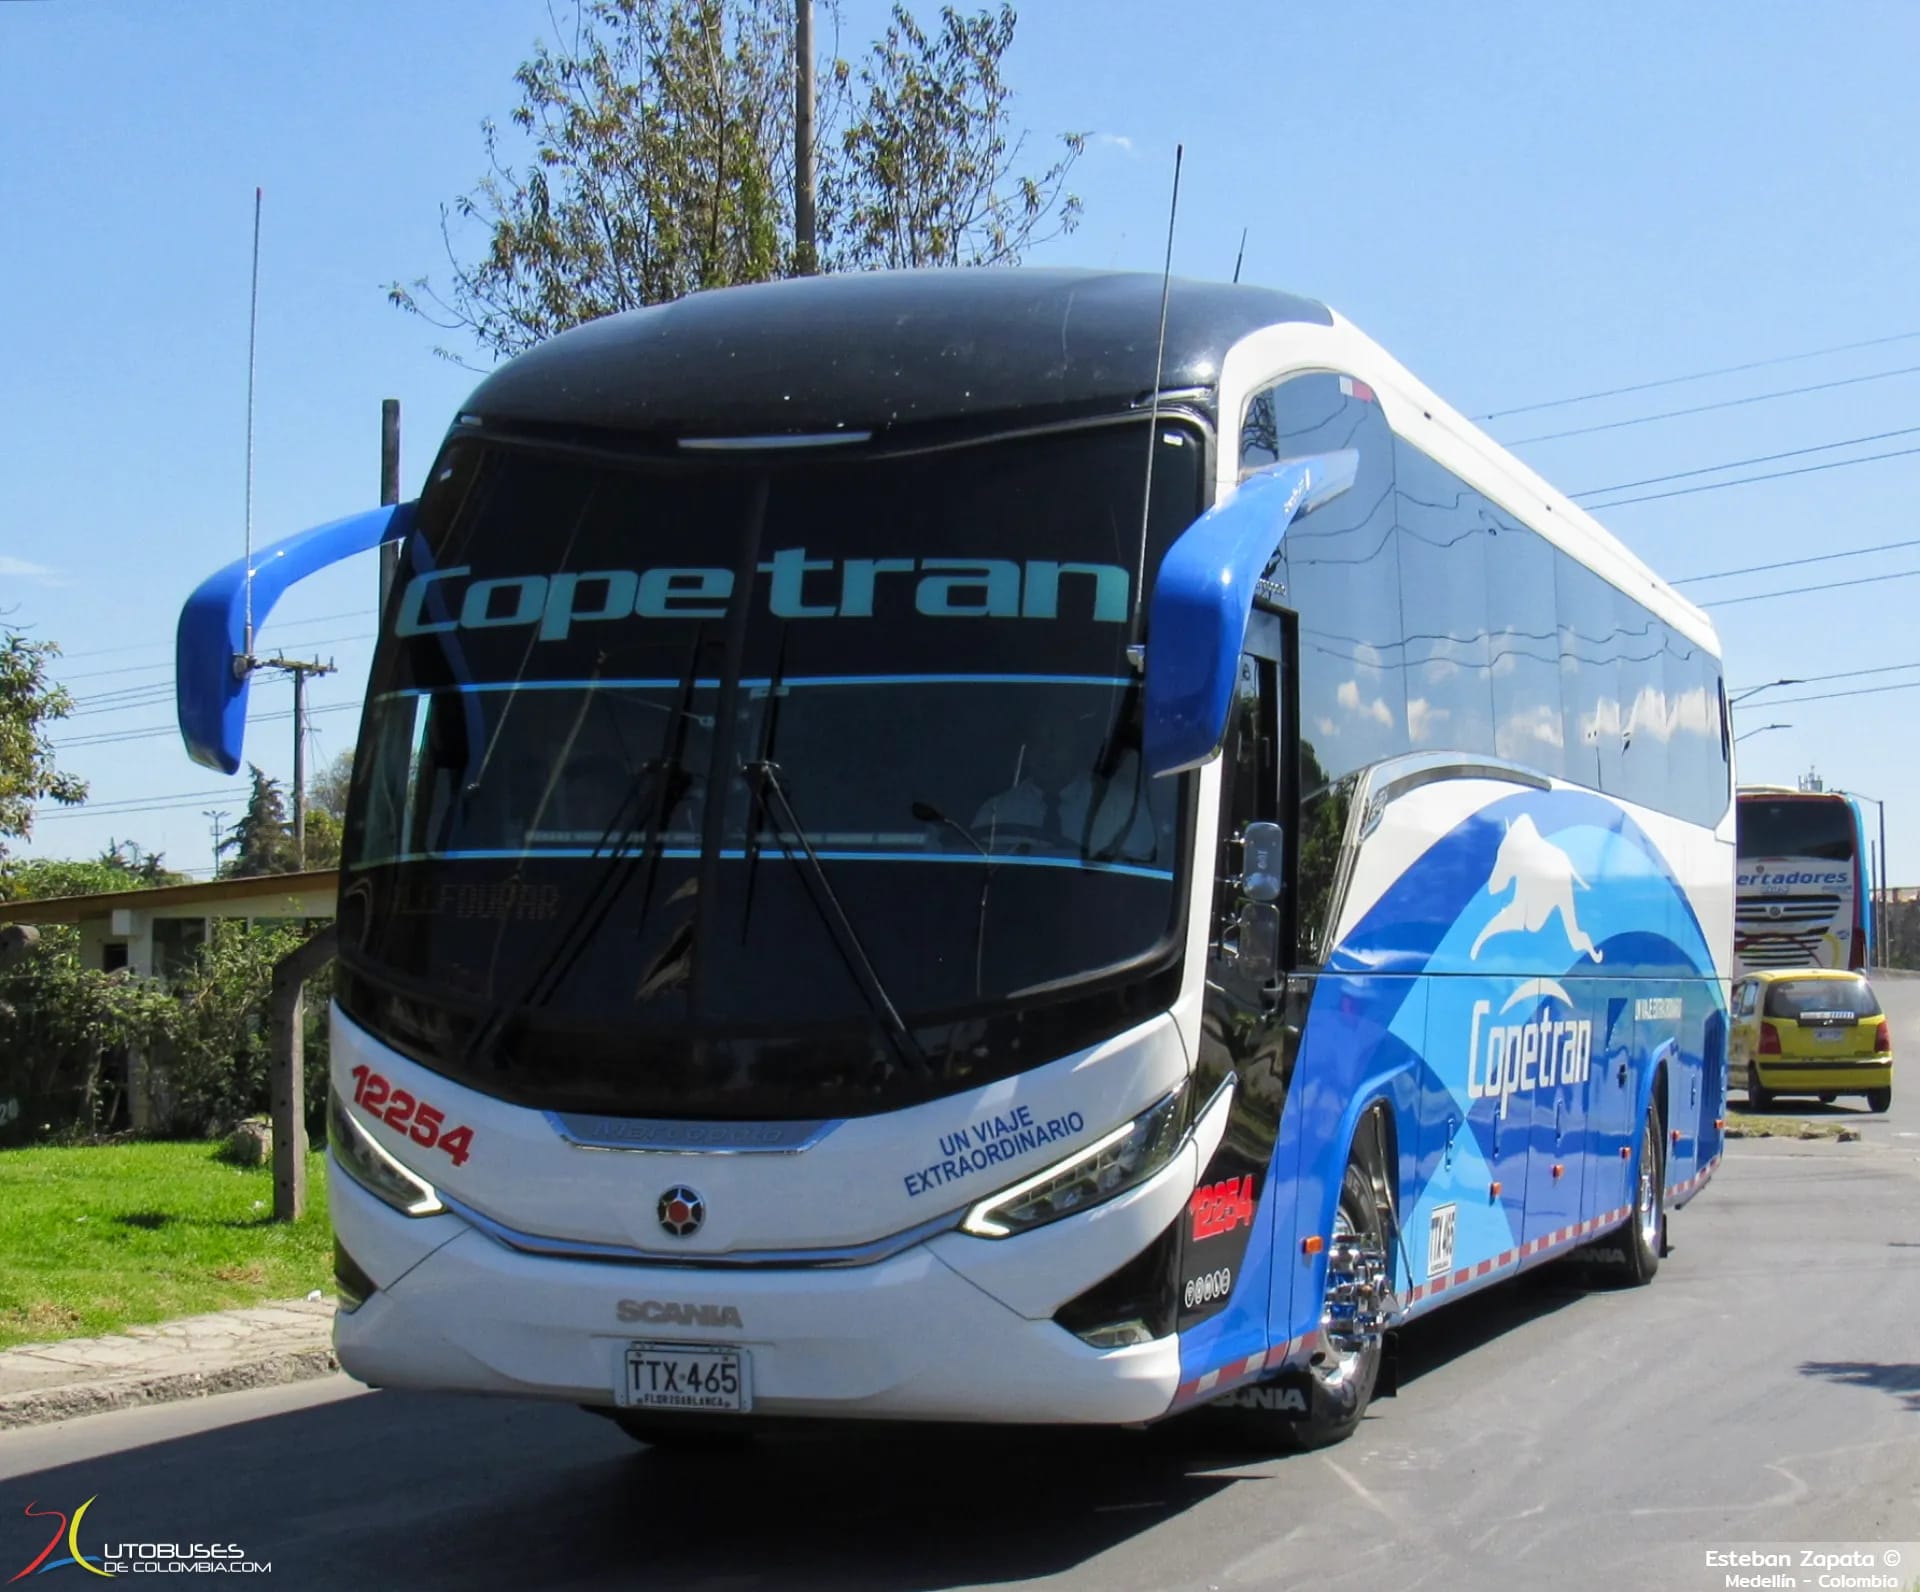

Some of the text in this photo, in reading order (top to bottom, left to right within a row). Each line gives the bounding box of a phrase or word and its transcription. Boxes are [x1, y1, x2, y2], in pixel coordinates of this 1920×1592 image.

[1468, 1000, 1591, 1120] Copetran
[352, 1064, 474, 1167] 12254
[939, 1105, 1034, 1157] UN VIAJE
[904, 1112, 1084, 1197] EXTRAORDINARIO
[1189, 1174, 1253, 1242] 12254
[616, 1299, 743, 1328] SCANIA
